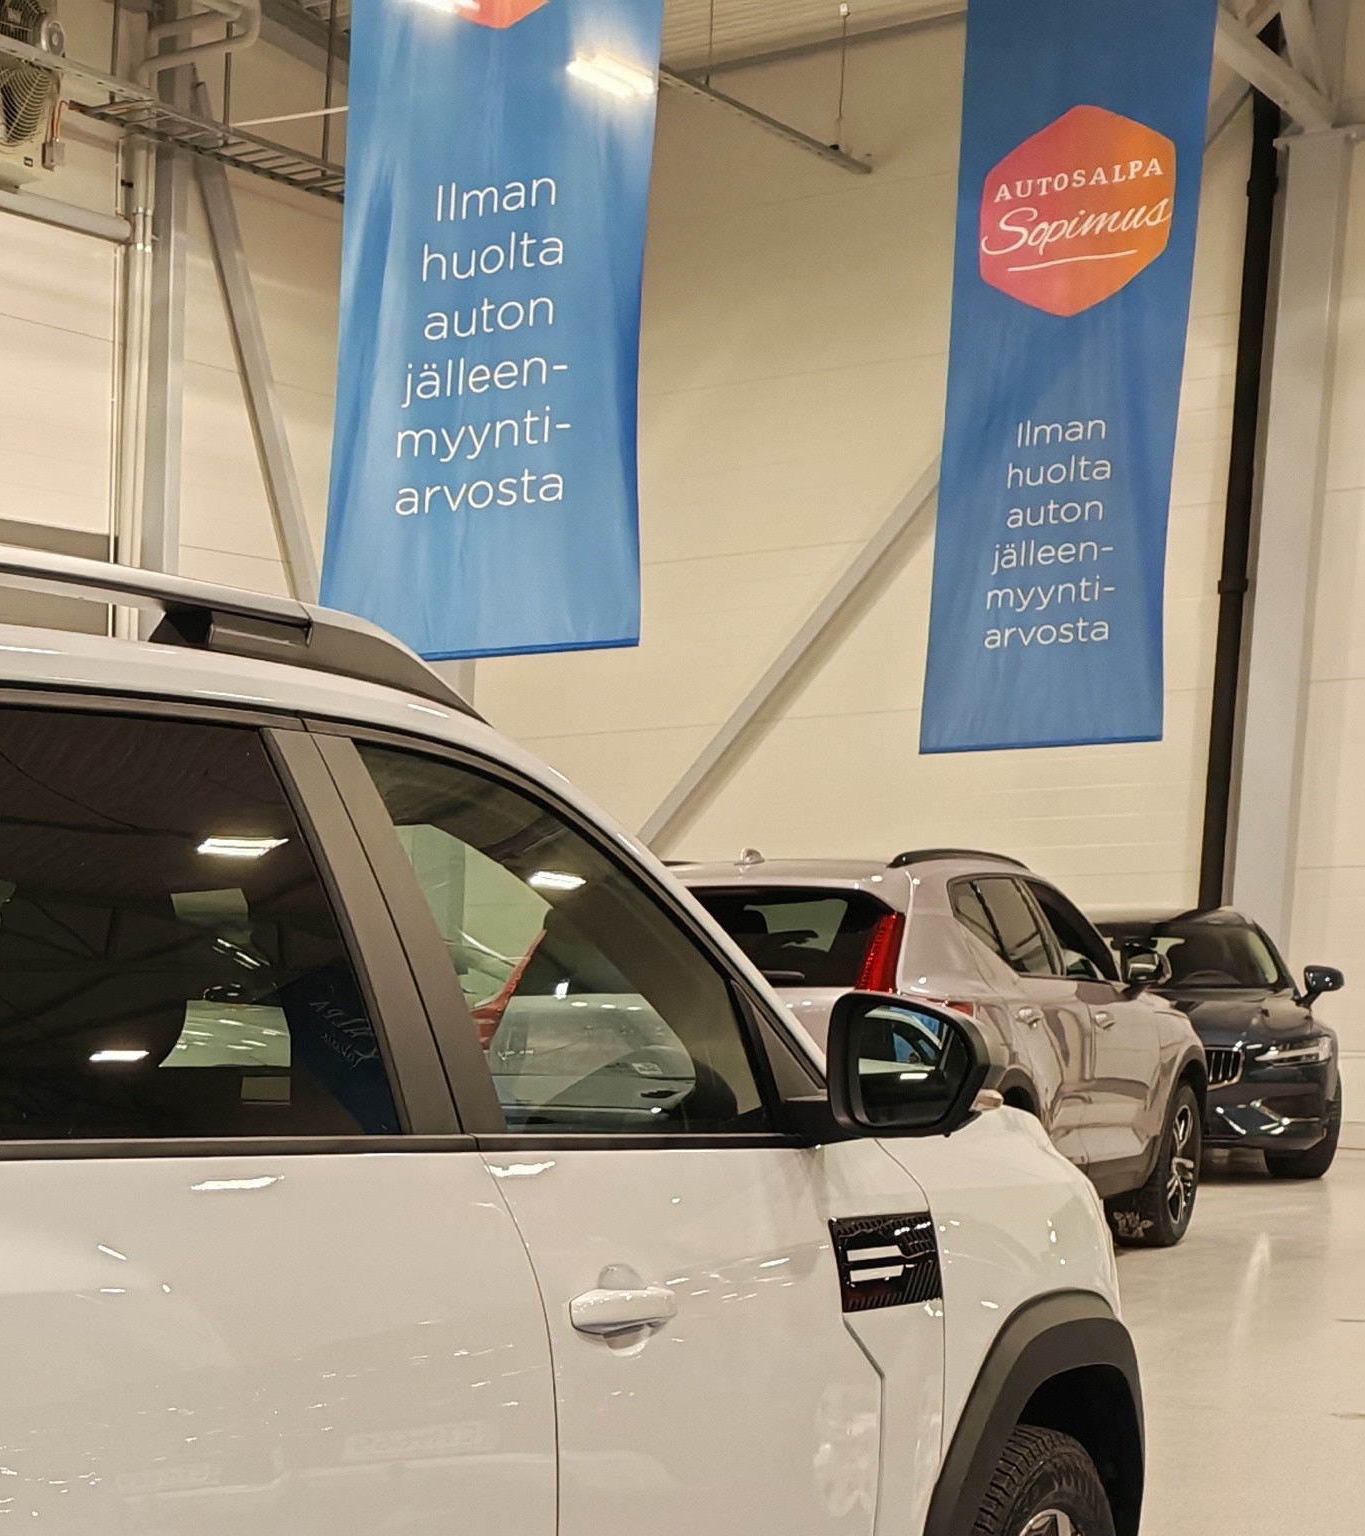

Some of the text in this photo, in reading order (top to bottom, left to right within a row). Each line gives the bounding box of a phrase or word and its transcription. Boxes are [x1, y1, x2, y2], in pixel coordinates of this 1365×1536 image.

[435, 176, 558, 223] Ilman
[994, 157, 1165, 203] AUTOSALPA
[980, 197, 1173, 256] Sopimus
[422, 231, 565, 282] huolta
[423, 295, 555, 341] auton
[401, 355, 570, 408] jälleen-
[395, 404, 572, 463] myynti-
[1016, 416, 1107, 449] Ilman
[395, 467, 566, 517] arvosta
[1006, 454, 1112, 490] huolta
[1005, 497, 1104, 531] auton
[989, 536, 1114, 576] jälleen-
[985, 575, 1116, 612] myynti-
[983, 616, 1111, 650] arvosta
